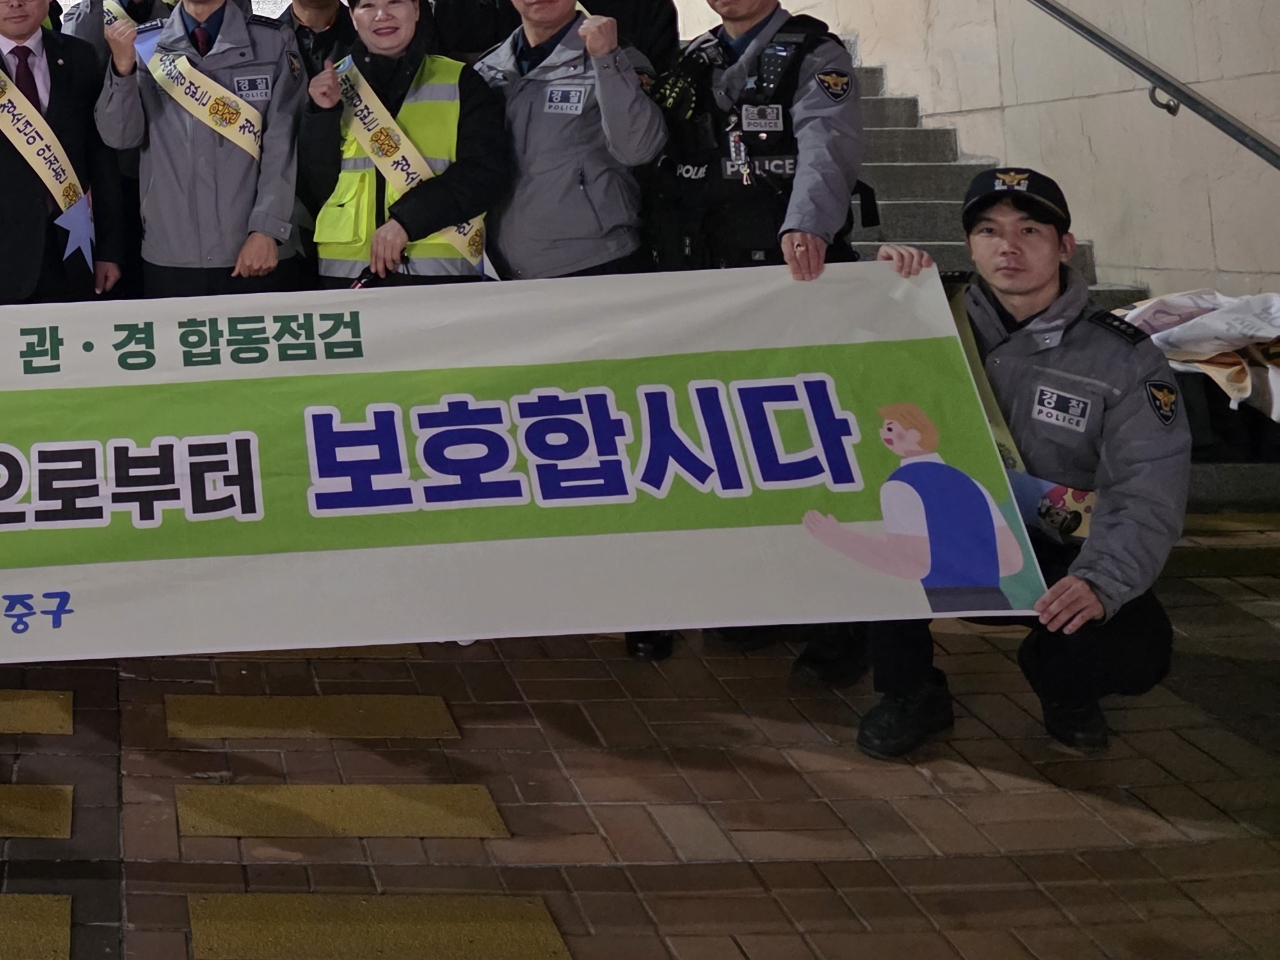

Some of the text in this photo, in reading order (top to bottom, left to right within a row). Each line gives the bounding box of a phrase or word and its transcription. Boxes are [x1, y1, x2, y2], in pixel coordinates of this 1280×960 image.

[184, 80, 212, 108] 없는
[208, 97, 242, 125] 인천
[238, 78, 267, 91] 경찰
[551, 90, 582, 103] 경찰
[547, 104, 580, 112] POLICE
[339, 74, 424, 186] 해환경 없는 인천 청소
[36, 143, 69, 186] 안전한
[177, 310, 364, 368] 합동점검
[1037, 408, 1081, 427] POLICE
[1041, 390, 1085, 417] 경찰
[307, 375, 858, 515] 보호합시다
[1, 591, 75, 634] 중구
